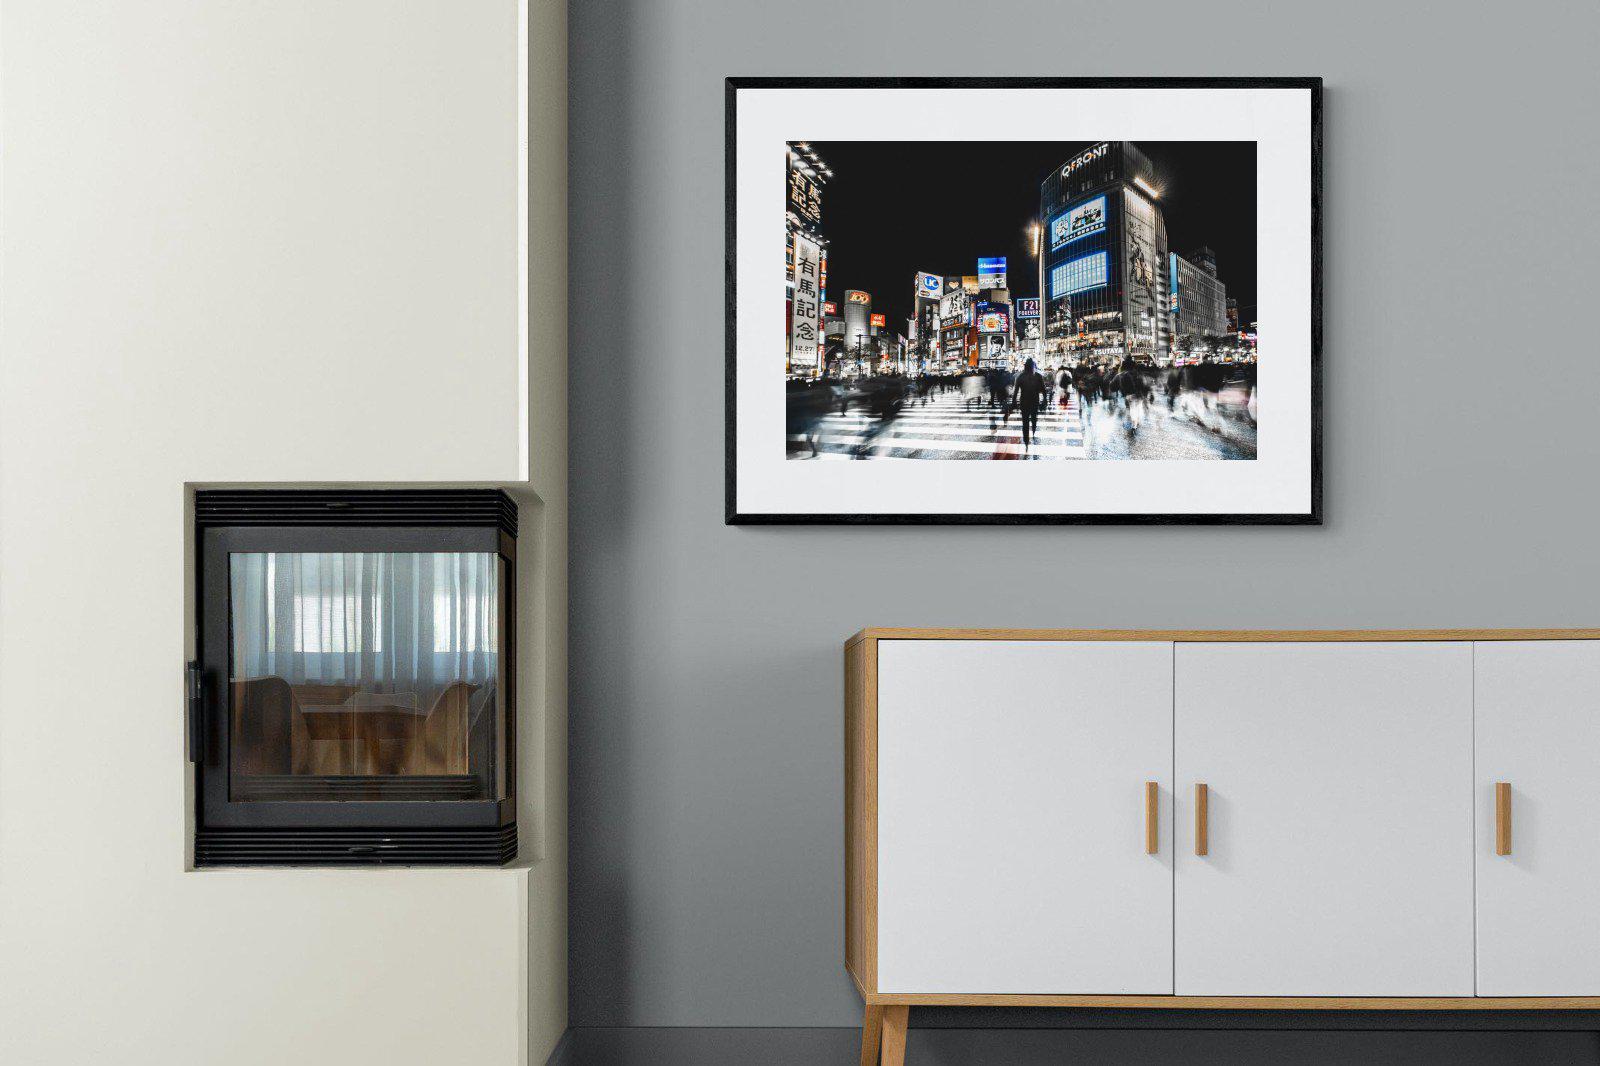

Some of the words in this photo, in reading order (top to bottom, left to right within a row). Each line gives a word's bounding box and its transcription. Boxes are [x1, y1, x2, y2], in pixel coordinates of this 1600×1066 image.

[1062, 143, 1108, 177] QFRONT
[924, 277, 939, 289] UC
[796, 257, 816, 341] 有馬記念
[1023, 300, 1039, 311] F21
[1094, 347, 1124, 355] TSUTAYA
